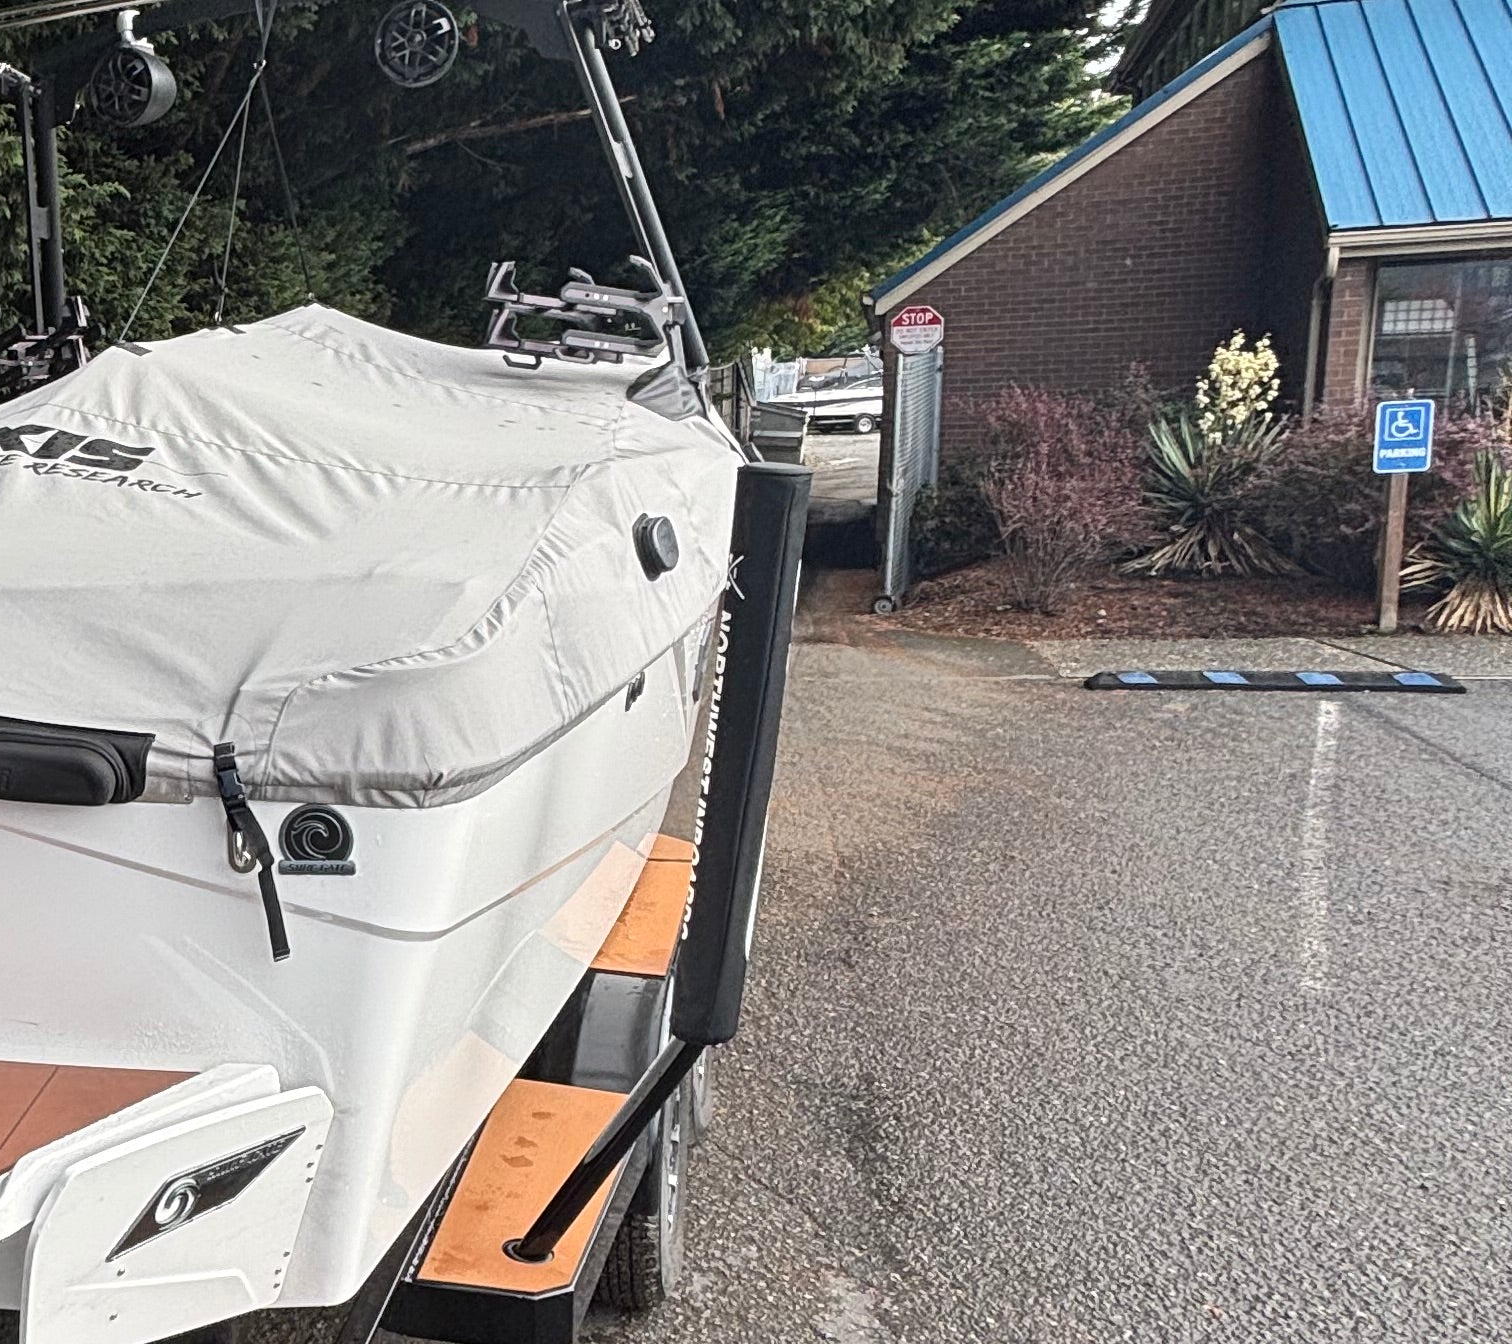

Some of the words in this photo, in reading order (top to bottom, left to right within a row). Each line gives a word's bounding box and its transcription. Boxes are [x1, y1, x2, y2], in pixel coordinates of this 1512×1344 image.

[901, 312, 934, 326] STOP
[1379, 447, 1426, 459] PARKING
[23, 461, 202, 498] RESEARCH
